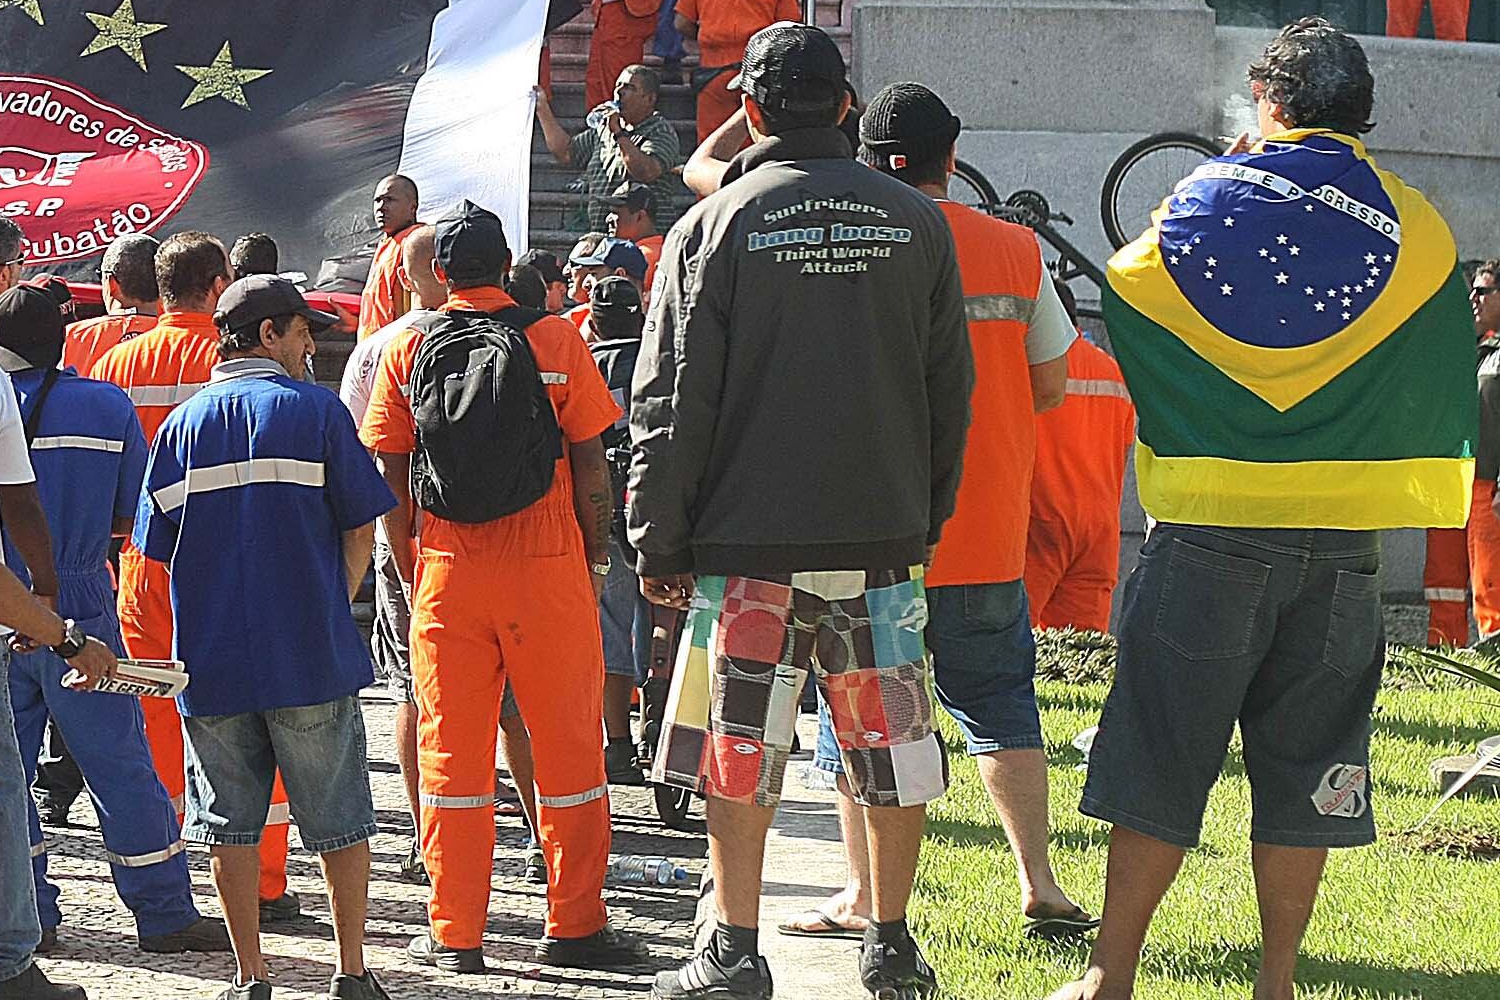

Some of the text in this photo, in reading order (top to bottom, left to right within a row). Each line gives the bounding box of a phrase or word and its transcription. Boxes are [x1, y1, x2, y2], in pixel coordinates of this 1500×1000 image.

[105, 126, 140, 147] de
[763, 197, 889, 225] Surfriders
[1262, 174, 1275, 187] E
[1287, 186, 1394, 235] POGRESSO
[748, 223, 912, 251] hang loose
[773, 247, 891, 263] Third World
[800, 261, 868, 274] Attack
